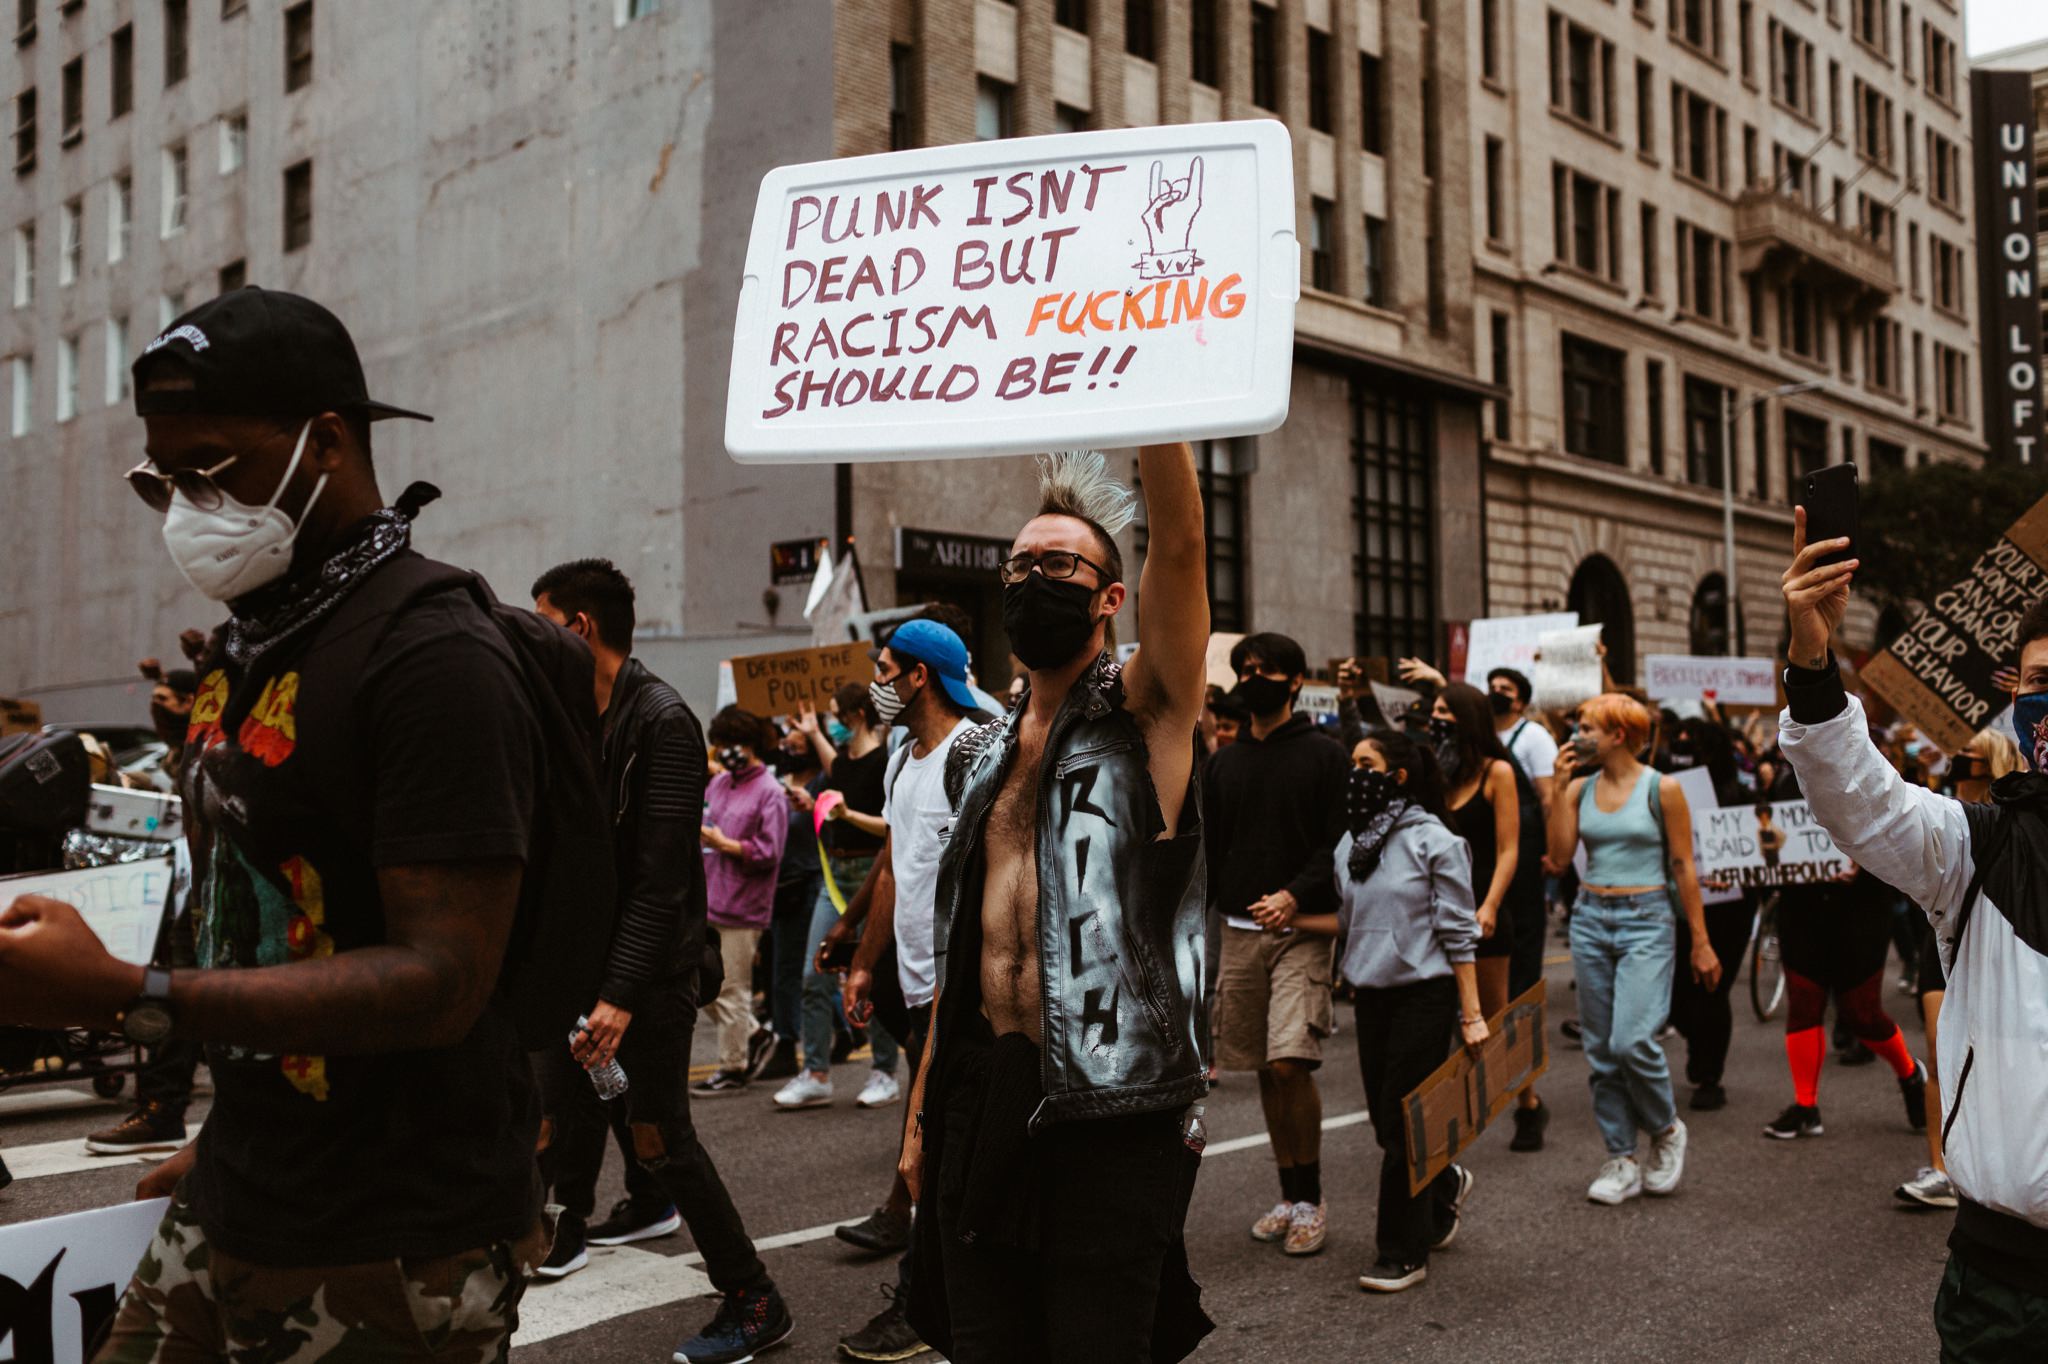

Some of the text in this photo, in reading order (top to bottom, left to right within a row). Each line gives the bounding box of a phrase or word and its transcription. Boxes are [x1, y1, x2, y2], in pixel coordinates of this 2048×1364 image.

[786, 183, 944, 252] PUNK
[2001, 123, 2032, 298] UNION
[781, 226, 1080, 310] DEAD BUT
[770, 272, 1247, 367] RACISM FUCKING
[762, 345, 1138, 420] SHOULD BE!!
[2009, 324, 2037, 464] LOFT
[1986, 537, 2038, 585] YOUR
[1910, 608, 1968, 664] YOUR
[1935, 590, 2016, 662] CHANGE
[1952, 578, 2022, 642] ANYON
[746, 650, 850, 679] DEFUND THE
[767, 676, 846, 708] POLICE
[1890, 632, 1990, 725] BEHAVIOR
[1705, 836, 1756, 862] SAID
[1798, 829, 1831, 854] TO
[1710, 810, 1743, 835] MY
